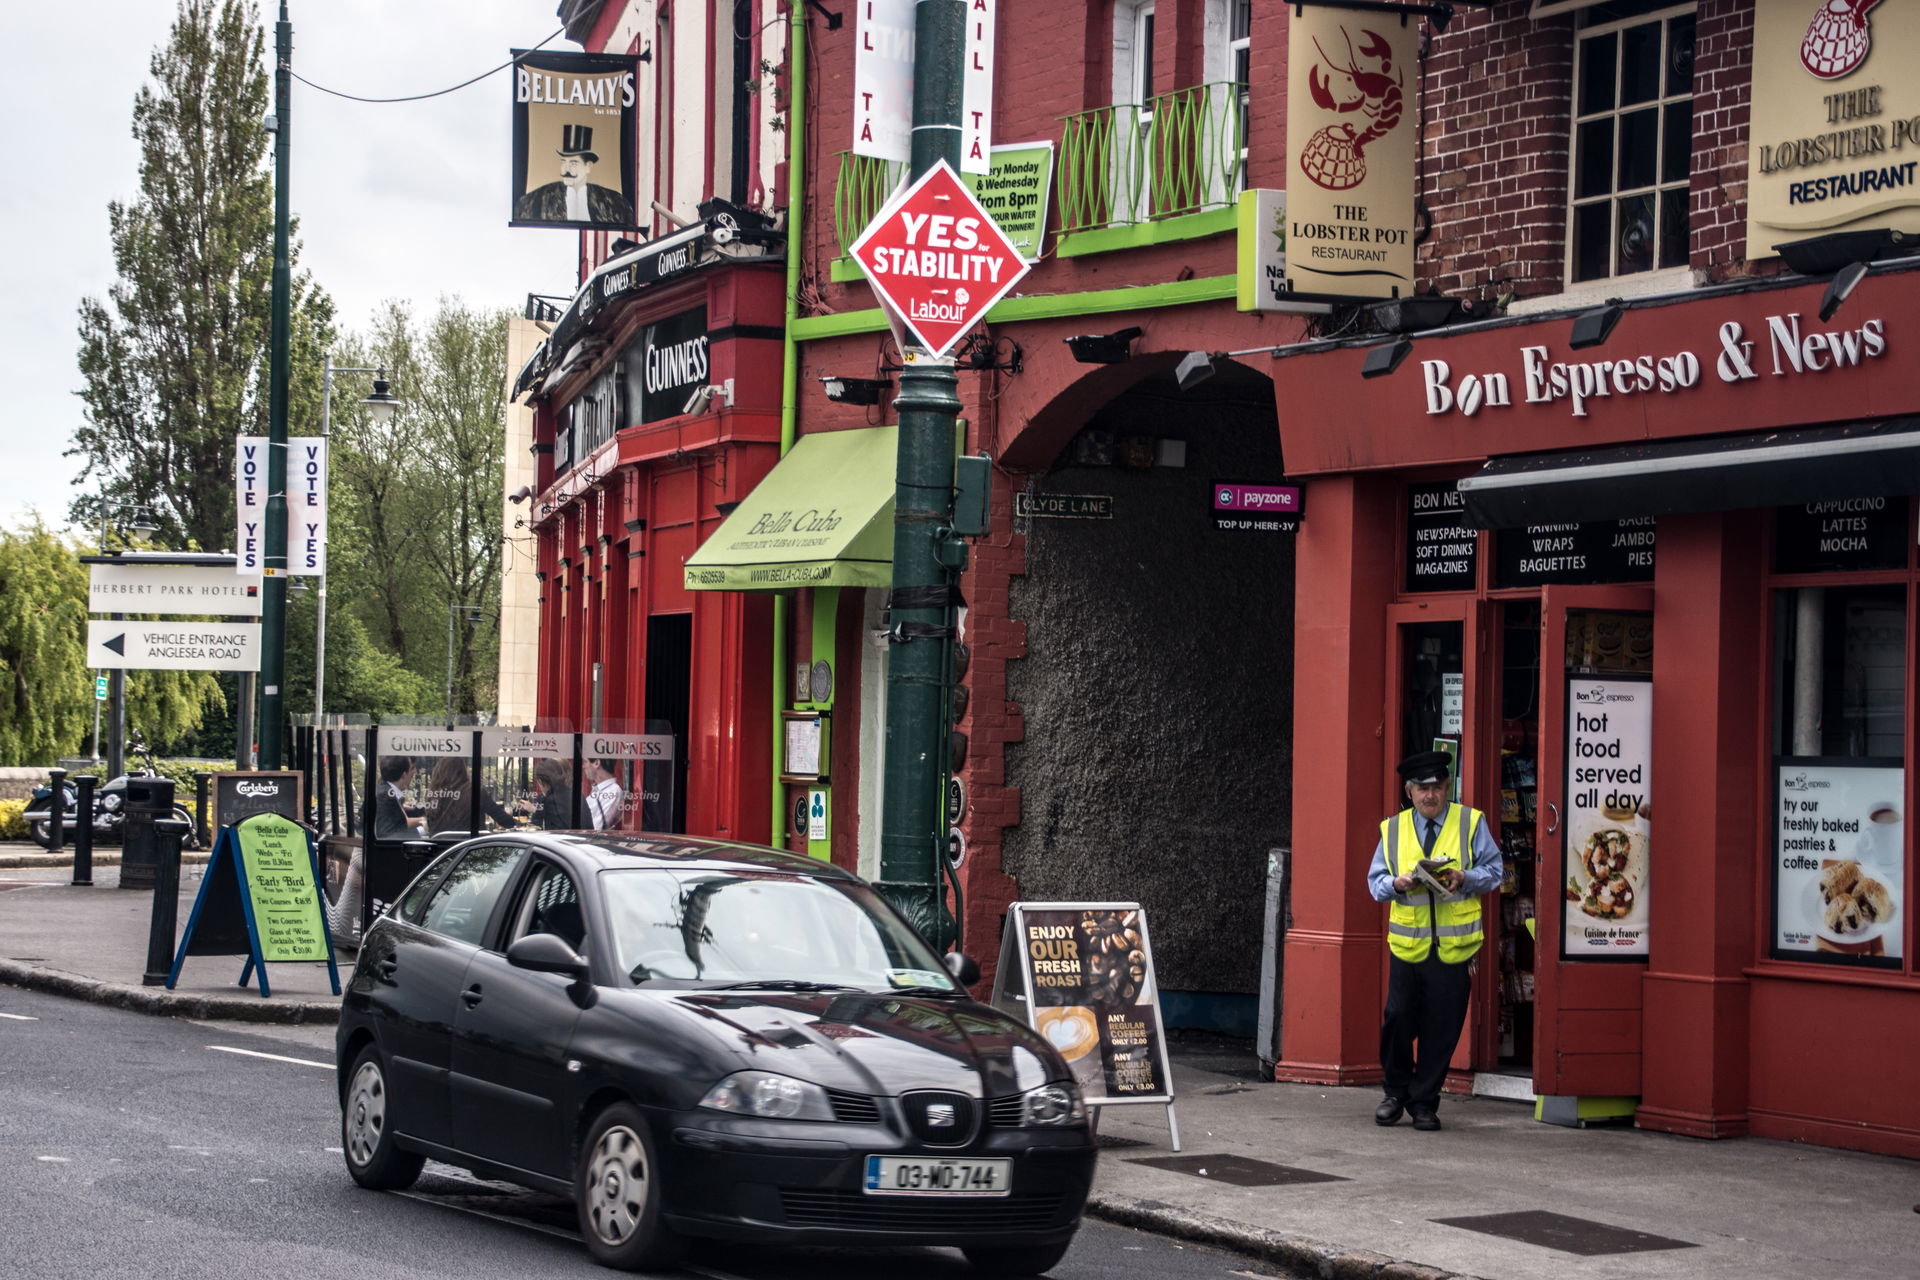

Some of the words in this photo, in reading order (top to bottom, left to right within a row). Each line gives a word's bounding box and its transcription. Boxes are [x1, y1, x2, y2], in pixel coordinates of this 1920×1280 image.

[517, 66, 635, 108] BELLAMY'S
[1824, 85, 1882, 122] THE
[1758, 124, 1884, 174] LOBSTER
[1004, 162, 1039, 174] Monday
[976, 180, 983, 190] &
[986, 176, 1039, 190] Wednesday
[1790, 162, 1918, 204] RESTAURANT
[1009, 192, 1038, 210] 8pm
[1010, 210, 1036, 220] WAITER
[1334, 204, 1367, 222] THE
[901, 212, 980, 250] YES
[978, 244, 990, 252] for
[1292, 222, 1370, 242] LOBSTER
[1375, 227, 1408, 245] POT
[658, 248, 686, 276] GUINNESS
[1312, 246, 1388, 262] RESTAURANT
[874, 247, 1004, 282] STABILITY
[910, 298, 967, 322] Labour
[646, 335, 708, 395] GUINNESS
[1421, 359, 1510, 416] Bon
[1520, 346, 1700, 417] Espresso
[1717, 320, 1758, 382] &
[1766, 313, 1886, 376] News
[244, 446, 256, 506] VOTE
[306, 446, 318, 506] VOTE
[1022, 498, 1066, 512] CLYDE
[1071, 500, 1106, 514] LANE
[1244, 493, 1291, 507] payzone
[1414, 492, 1439, 509] BON
[1806, 497, 1885, 514] CAPPUCCINO
[746, 511, 792, 535] Bella
[792, 508, 842, 532] Cuba
[1218, 520, 1237, 529] TOP
[1239, 521, 1252, 529] UP
[1822, 517, 1867, 532] LATTES
[1416, 527, 1477, 542] NEWSPAPERS
[245, 523, 257, 566] YES
[306, 523, 318, 568] YES
[1416, 545, 1438, 558] SOFT
[1441, 543, 1473, 556] DRINKS
[1532, 537, 1574, 552] WRAPS
[1820, 537, 1868, 552] MOCHA
[1520, 556, 1586, 572] BAGUETTES
[1628, 552, 1653, 567] PIES
[1416, 561, 1468, 575] MAGAZINES
[93, 584, 152, 594] HERBERT
[161, 585, 194, 595] PARK
[202, 586, 245, 596] HOTEL
[144, 633, 186, 645] VEHICLE
[189, 634, 246, 646] ENTRANCE
[148, 648, 205, 658] ANGLESEA
[209, 649, 241, 659] ROAD
[1576, 692, 1589, 700] Bon
[1576, 712, 1608, 733] hot
[391, 736, 462, 752] GUINNESS
[594, 738, 662, 756] GUINNESS
[1576, 738, 1620, 758] food
[1576, 764, 1642, 784] served
[236, 781, 279, 796] Carlsberg
[1576, 789, 1598, 809] all
[1605, 789, 1644, 813] day
[1784, 798, 1797, 814] try
[1800, 801, 1818, 812] our
[1784, 816, 1819, 834] freshly
[1822, 818, 1859, 833] baked
[1784, 837, 1825, 852] pastries
[1828, 838, 1836, 851] &
[1783, 857, 1818, 870] coffee
[256, 876, 280, 886] Early
[282, 876, 305, 886] Bird
[1029, 926, 1075, 940] ENJOY
[1030, 940, 1078, 960] OUR
[1034, 960, 1081, 974] FRESH
[1036, 974, 1082, 987] ROAST
[1108, 1014, 1125, 1022] ANY
[1109, 1022, 1145, 1030] REGULAR
[1110, 1029, 1147, 1038] COFFEE
[1114, 1053, 1131, 1061] ANY
